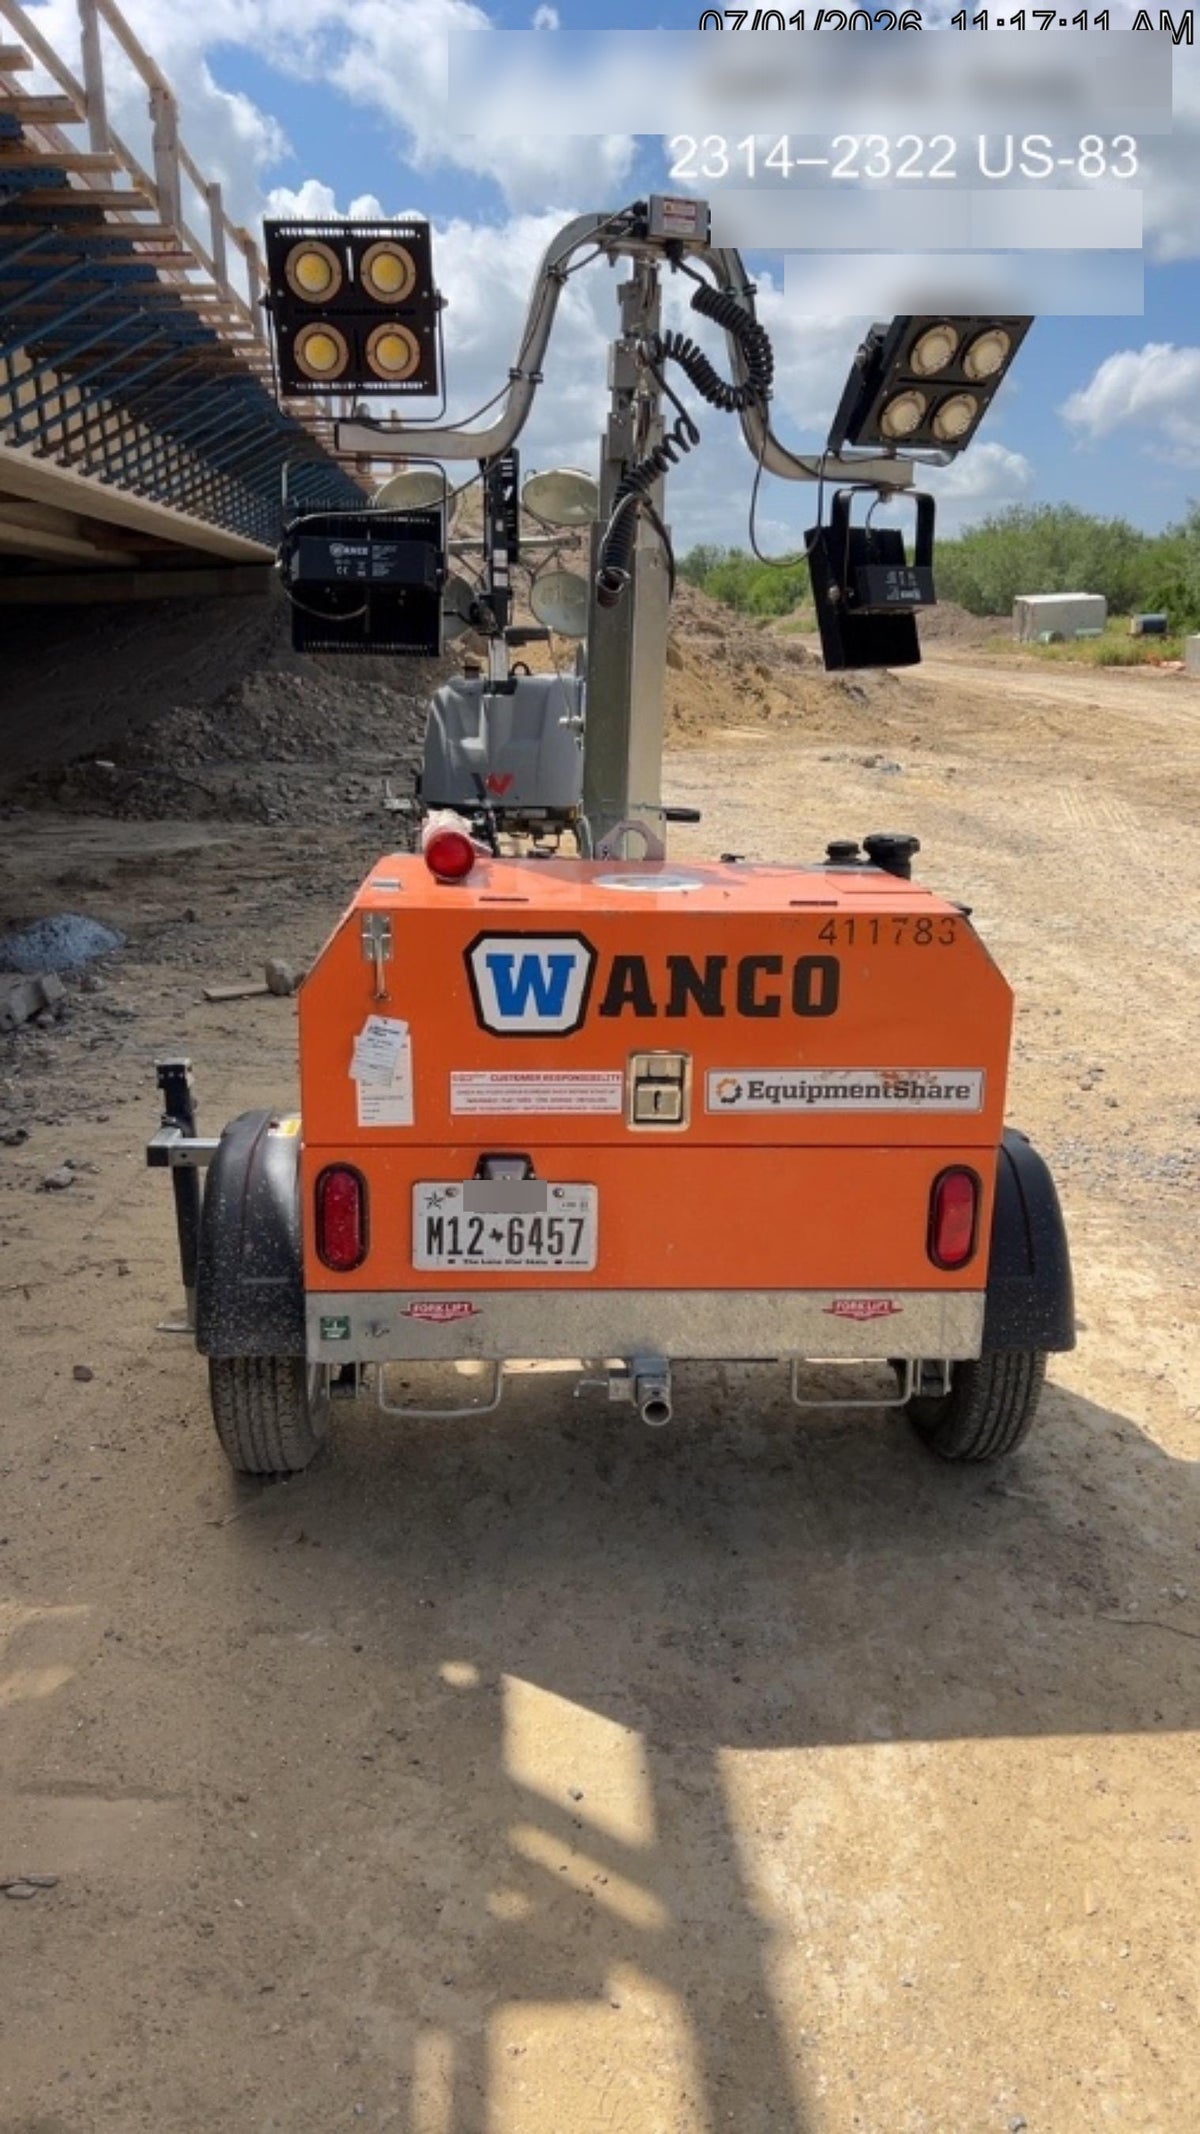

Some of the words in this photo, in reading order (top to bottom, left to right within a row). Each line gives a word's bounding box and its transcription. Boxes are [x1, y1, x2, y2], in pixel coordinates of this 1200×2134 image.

[818, 917, 956, 945] 411783
[484, 952, 840, 1018] WANCO
[490, 1074, 541, 1082] CUSTOMER
[747, 1080, 971, 1104] EquipmentShare
